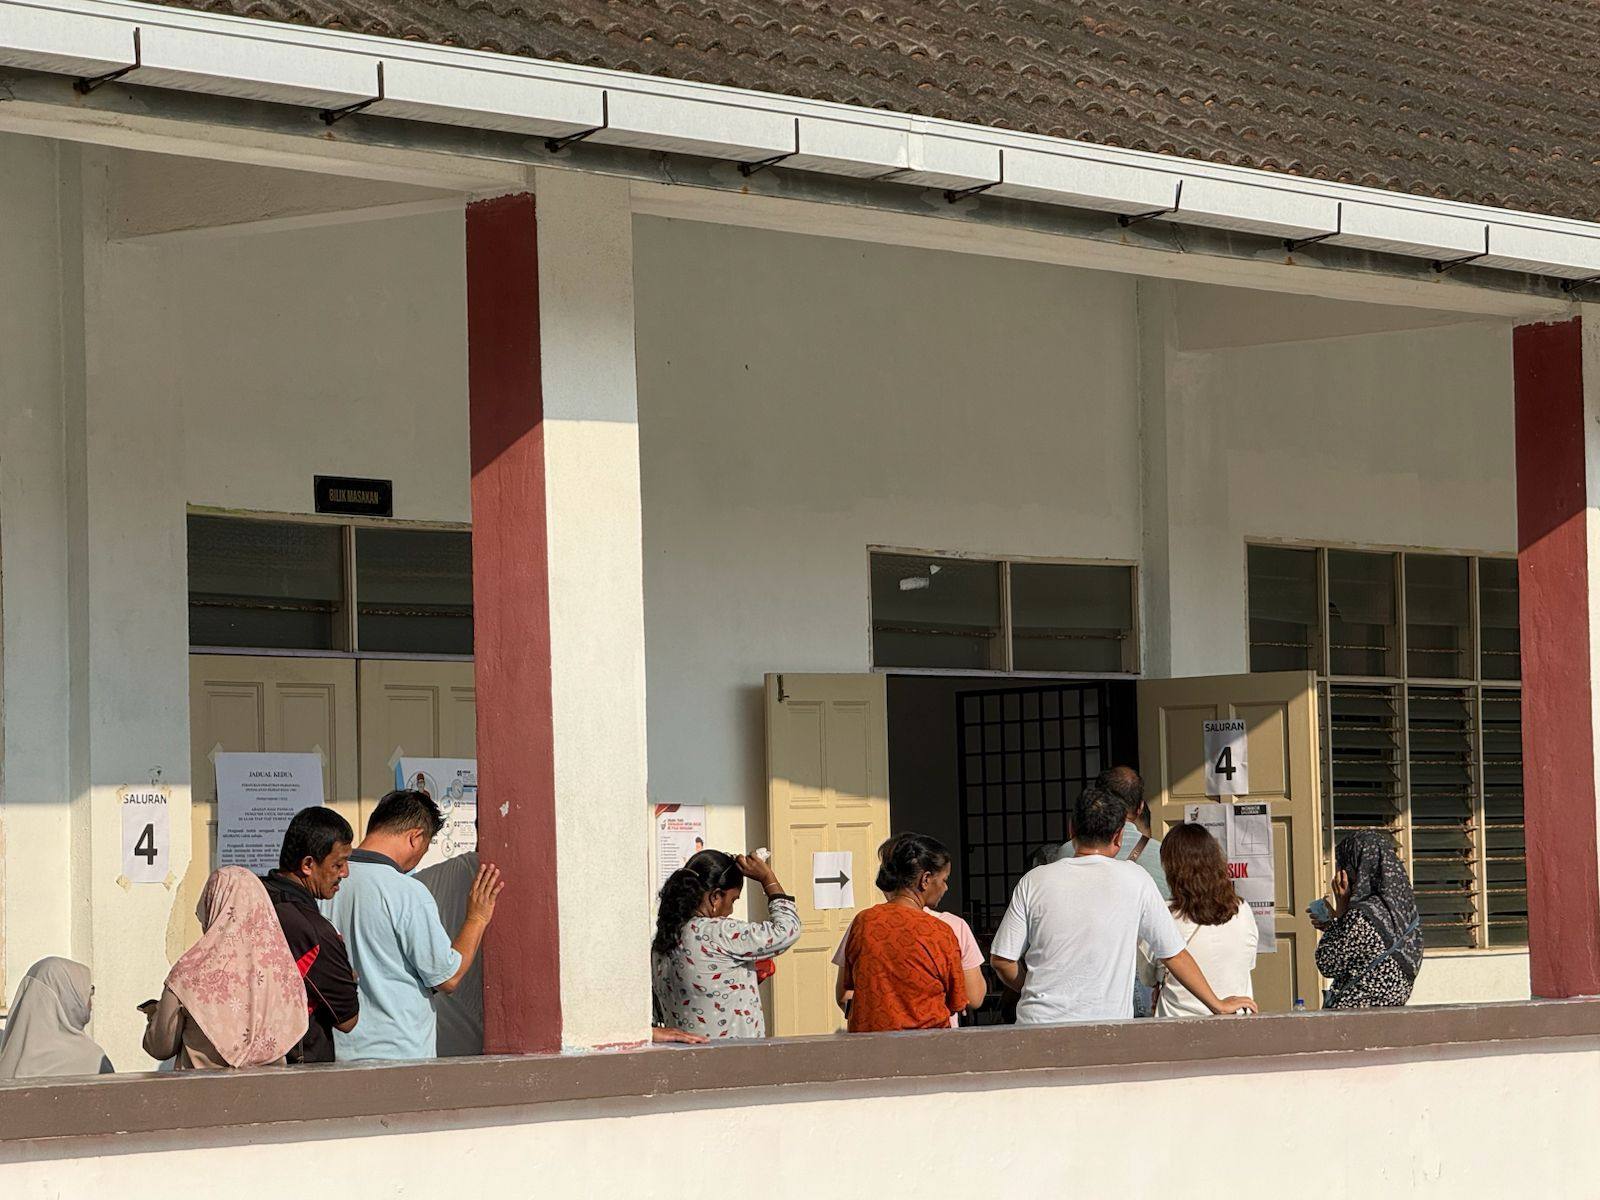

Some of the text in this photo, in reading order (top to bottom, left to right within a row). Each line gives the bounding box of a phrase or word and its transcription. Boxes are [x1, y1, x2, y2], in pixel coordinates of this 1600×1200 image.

[328, 488, 378, 505] BILIK MASAKAN
[1205, 723, 1244, 733] SALURAN
[1215, 746, 1236, 781] 4
[123, 794, 167, 805] SALURAN
[134, 823, 158, 866] 4
[1227, 863, 1249, 879] SUK
